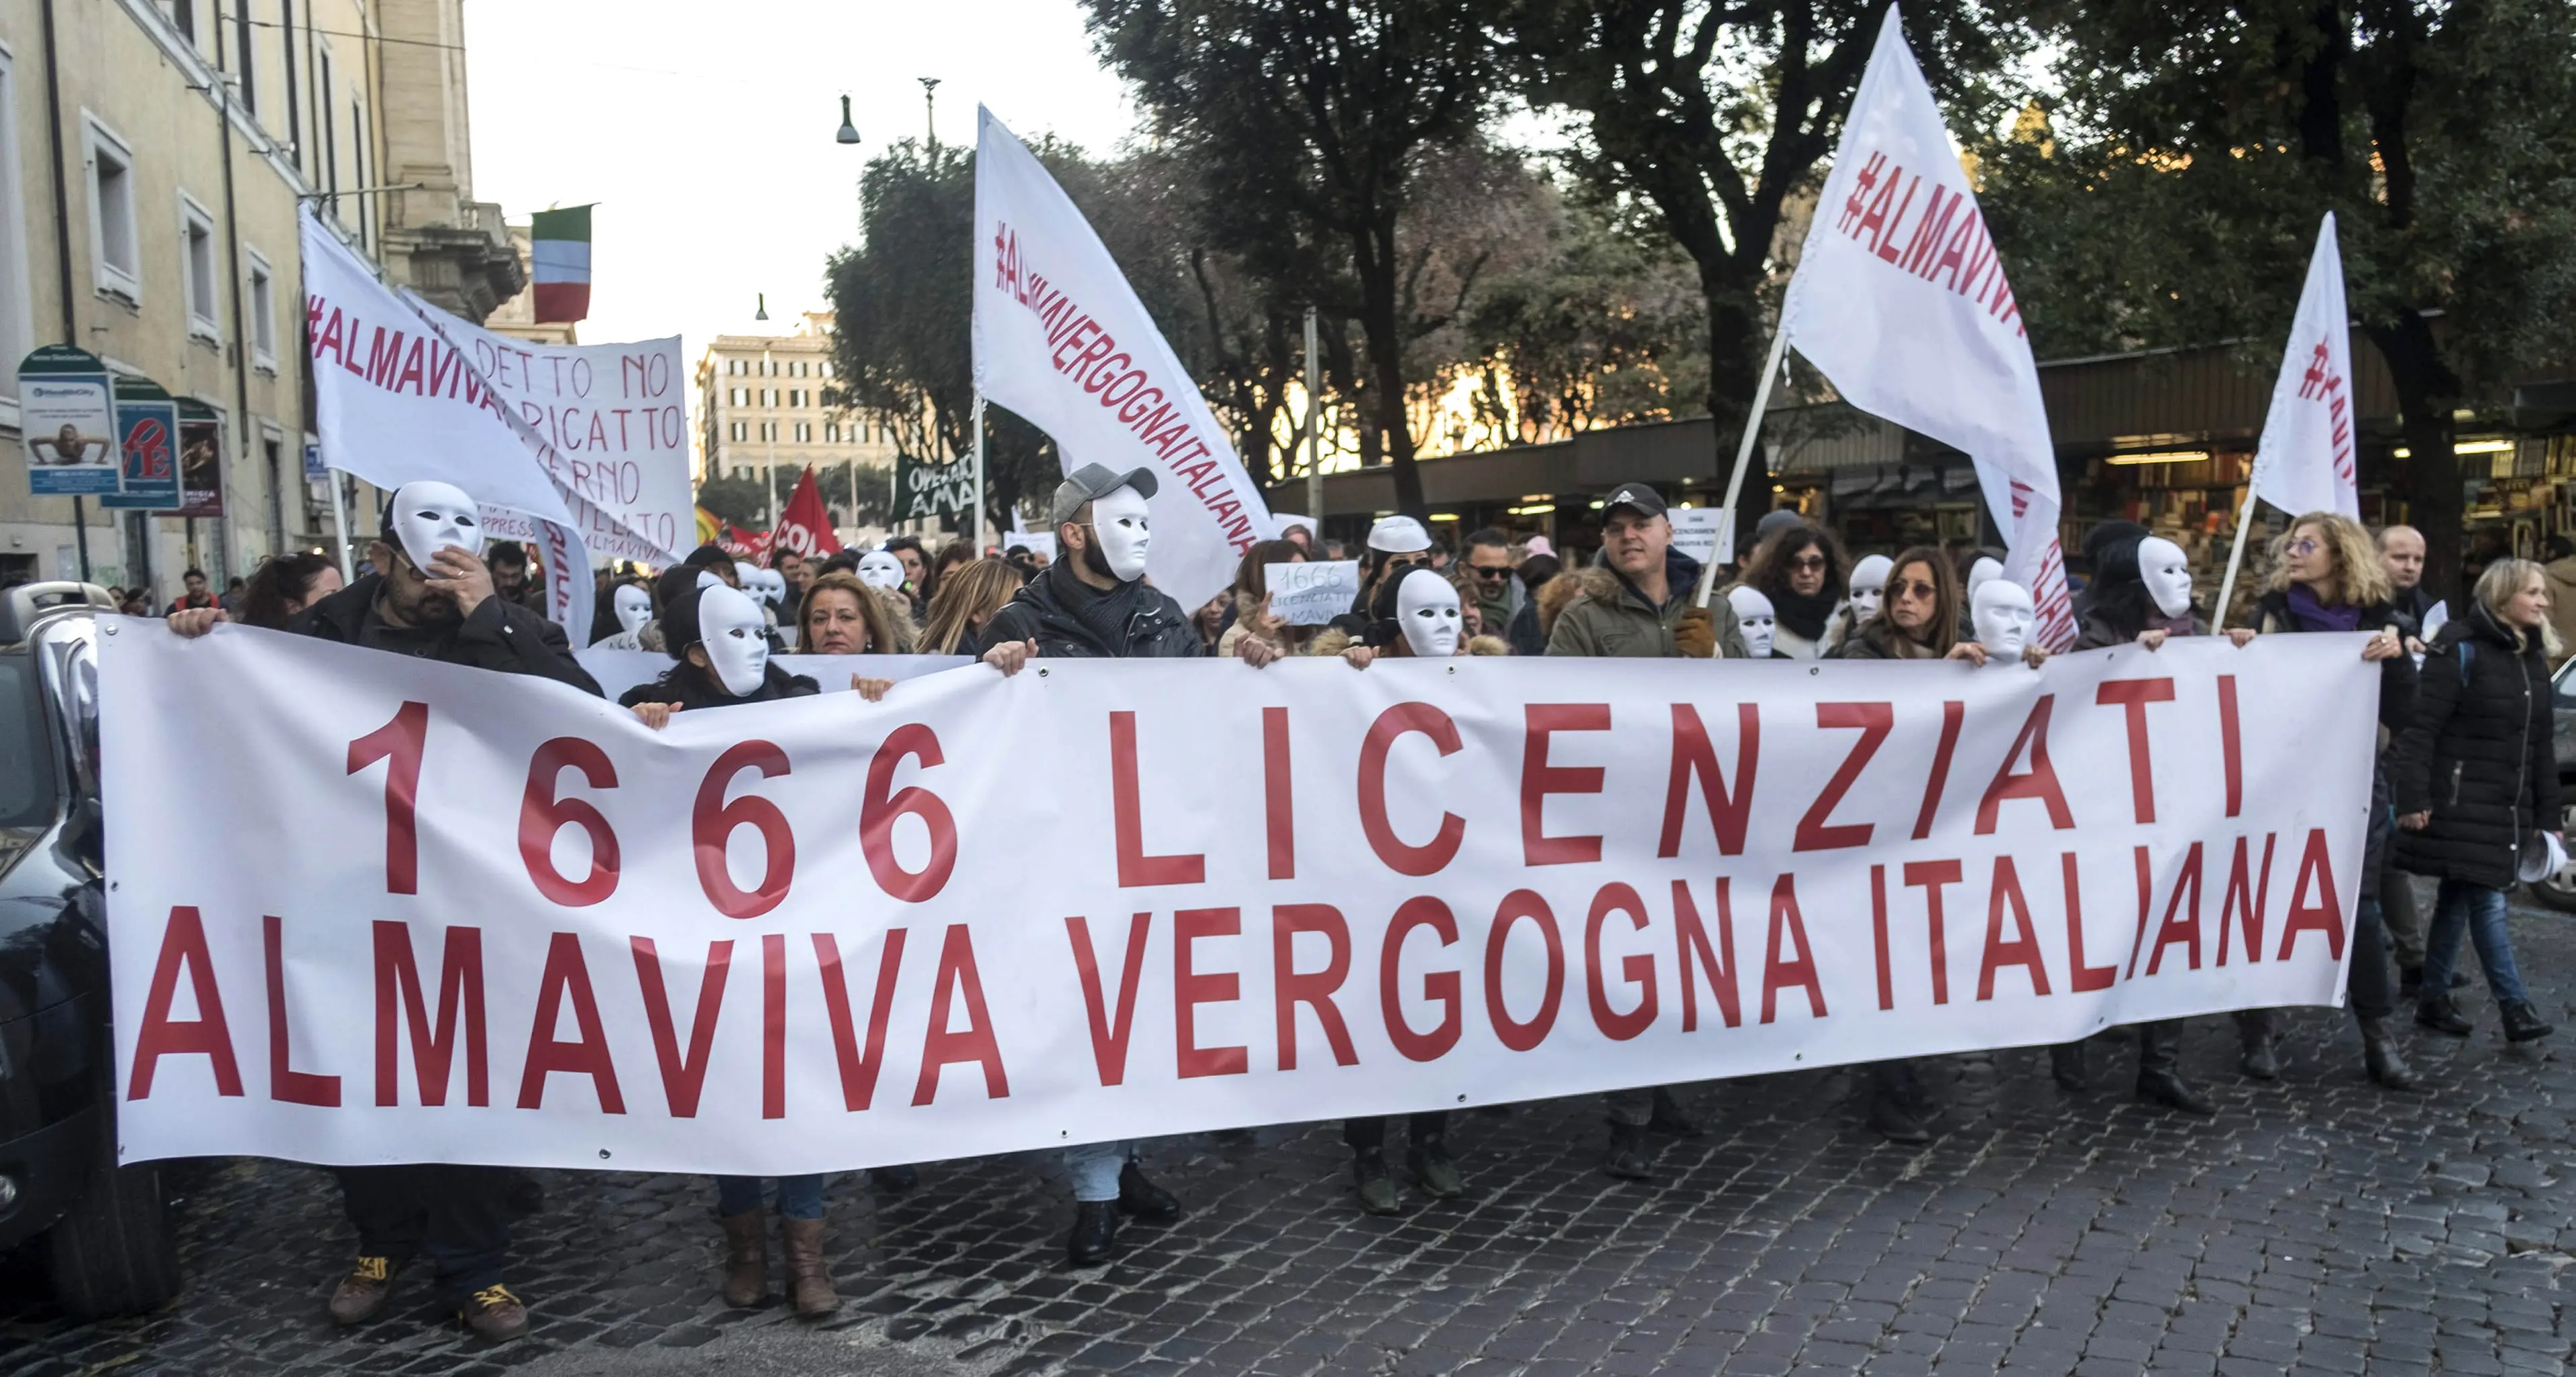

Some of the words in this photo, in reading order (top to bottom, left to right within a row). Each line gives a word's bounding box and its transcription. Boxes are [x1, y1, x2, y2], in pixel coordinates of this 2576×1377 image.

[621, 353, 669, 398] NO
[347, 701, 958, 920] 1666
[1110, 674, 2243, 888] LICENZIATI
[127, 905, 1009, 1120] ALMAVIVA
[1067, 873, 1827, 1087] VERGOGNA
[1872, 828, 2346, 1011] ITALIANA
